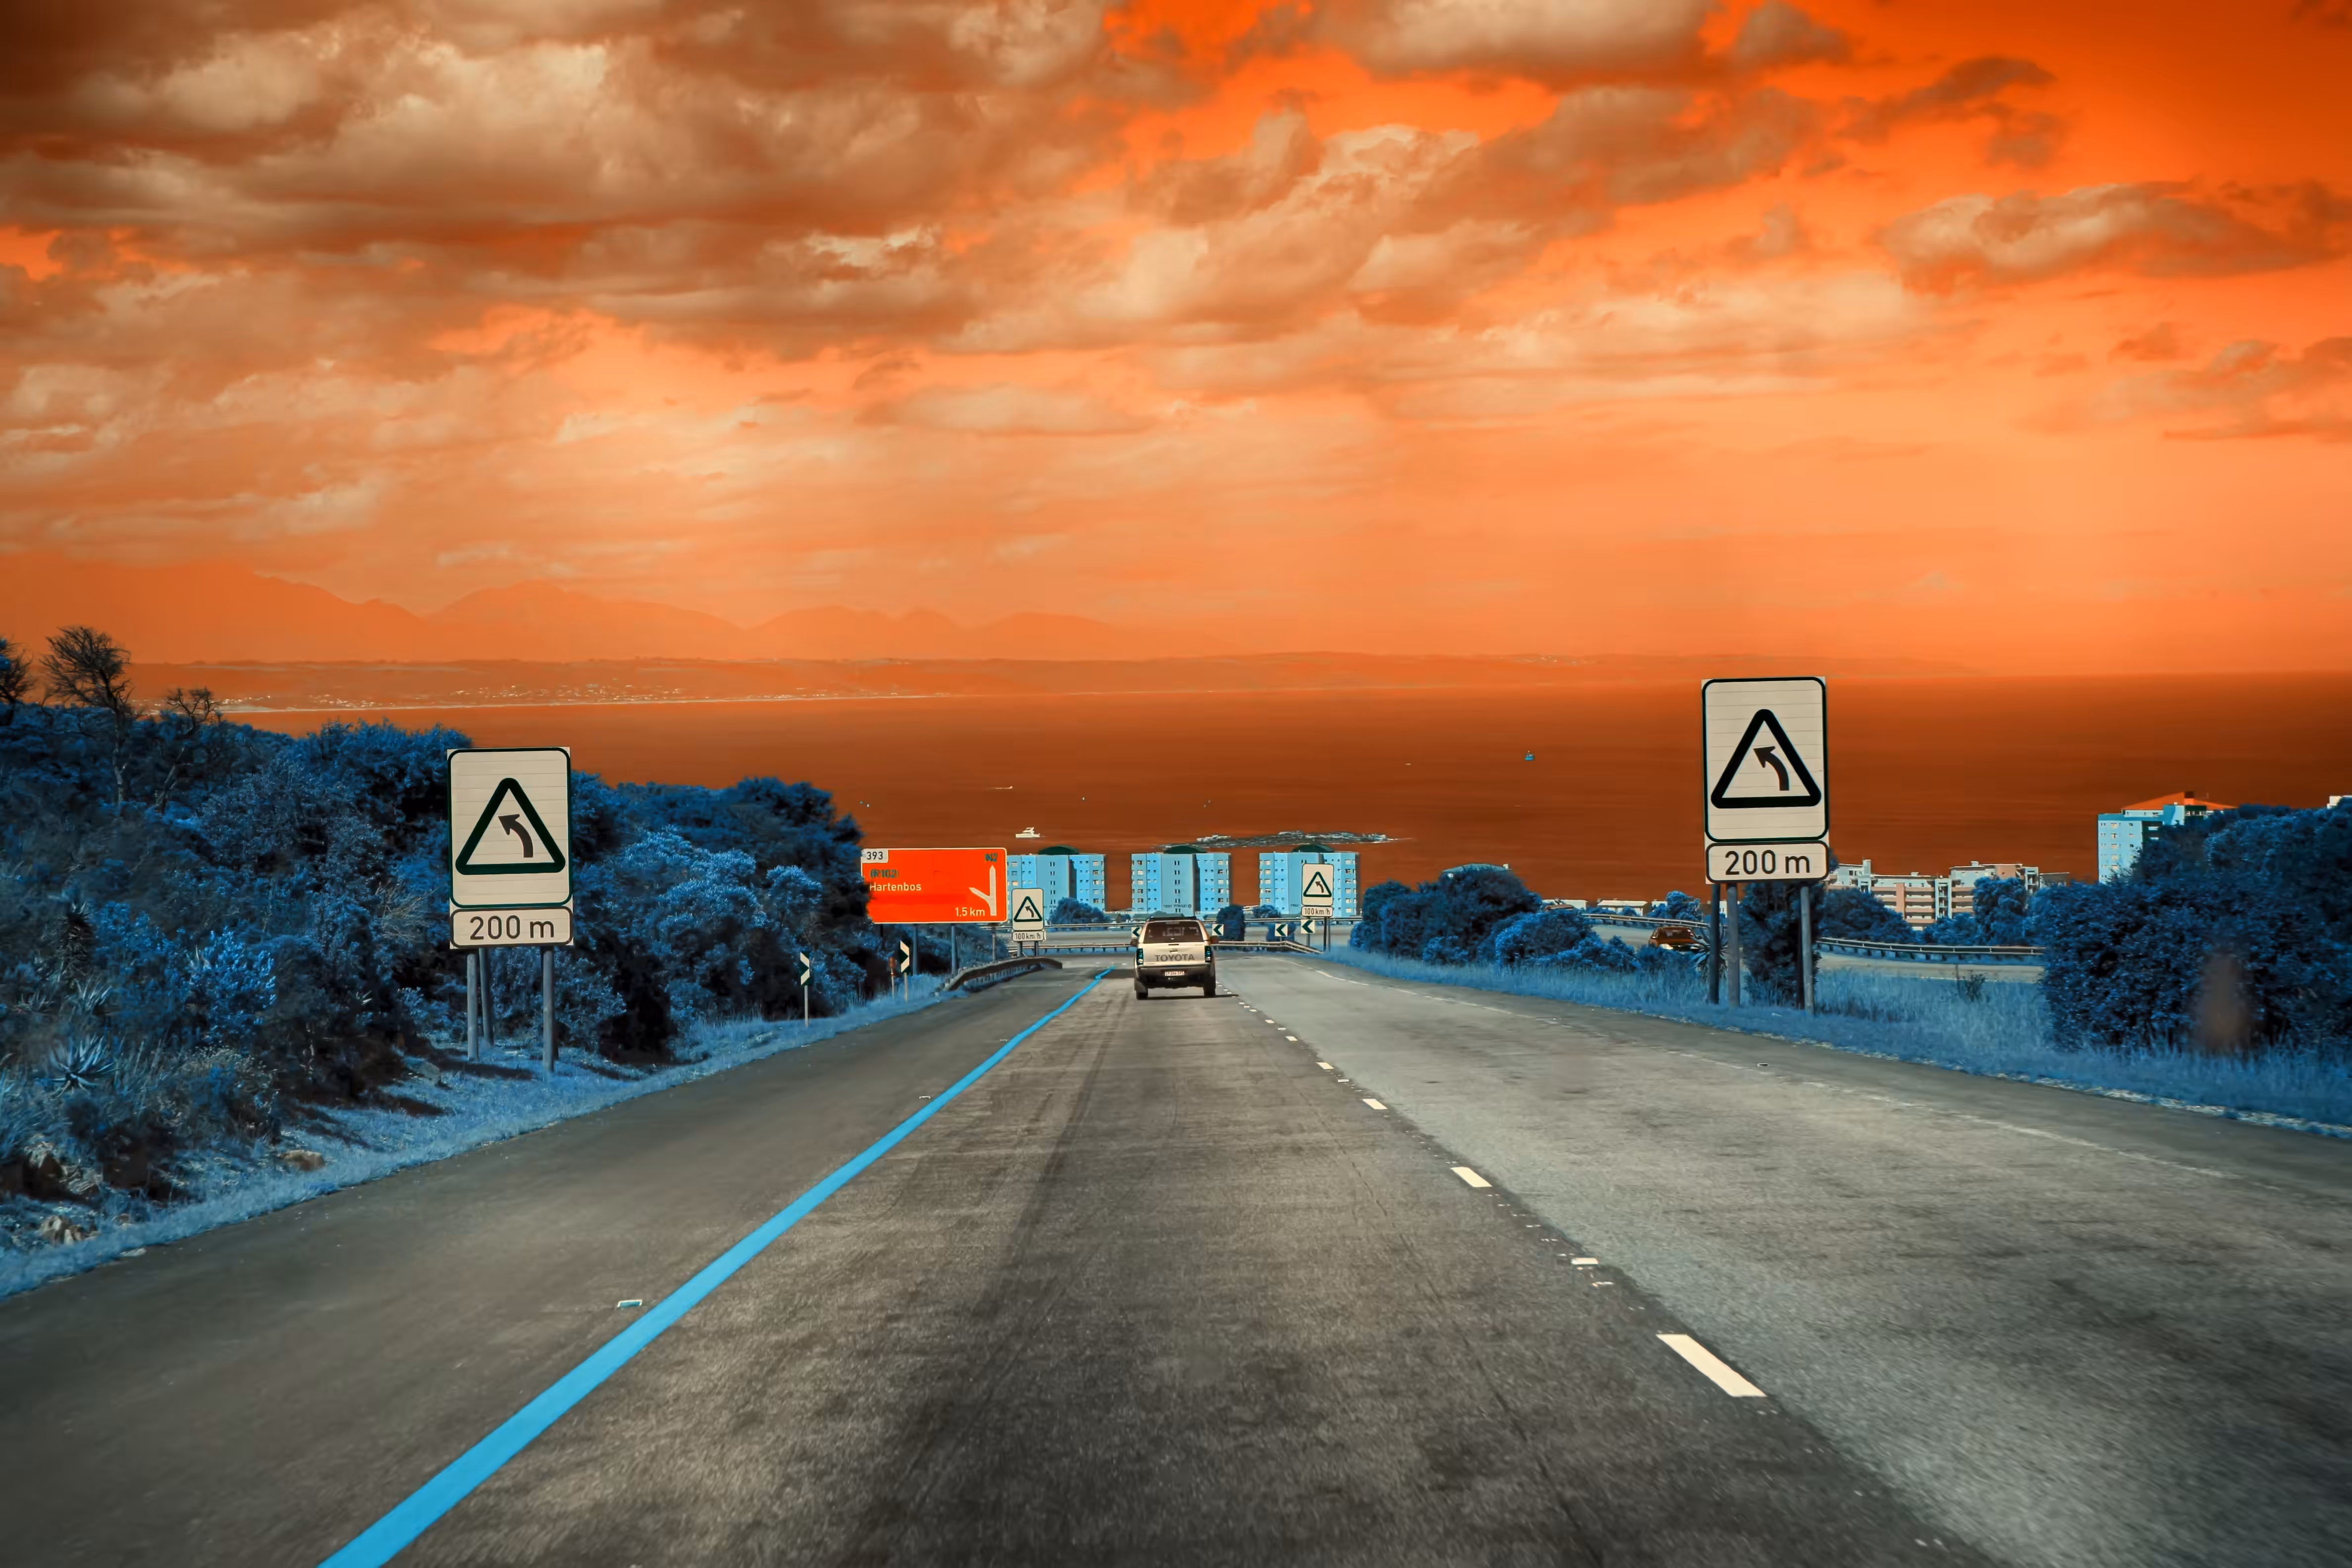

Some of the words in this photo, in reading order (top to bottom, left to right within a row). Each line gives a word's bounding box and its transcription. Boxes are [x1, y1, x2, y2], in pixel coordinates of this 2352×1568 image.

[867, 851, 883, 860] 393
[984, 853, 998, 862] N2
[1725, 849, 1776, 875] 200
[1785, 855, 1810, 874] m
[870, 882, 922, 891] Hartenbos
[970, 907, 985, 916] km
[470, 915, 520, 939] 200
[530, 919, 554, 938] m
